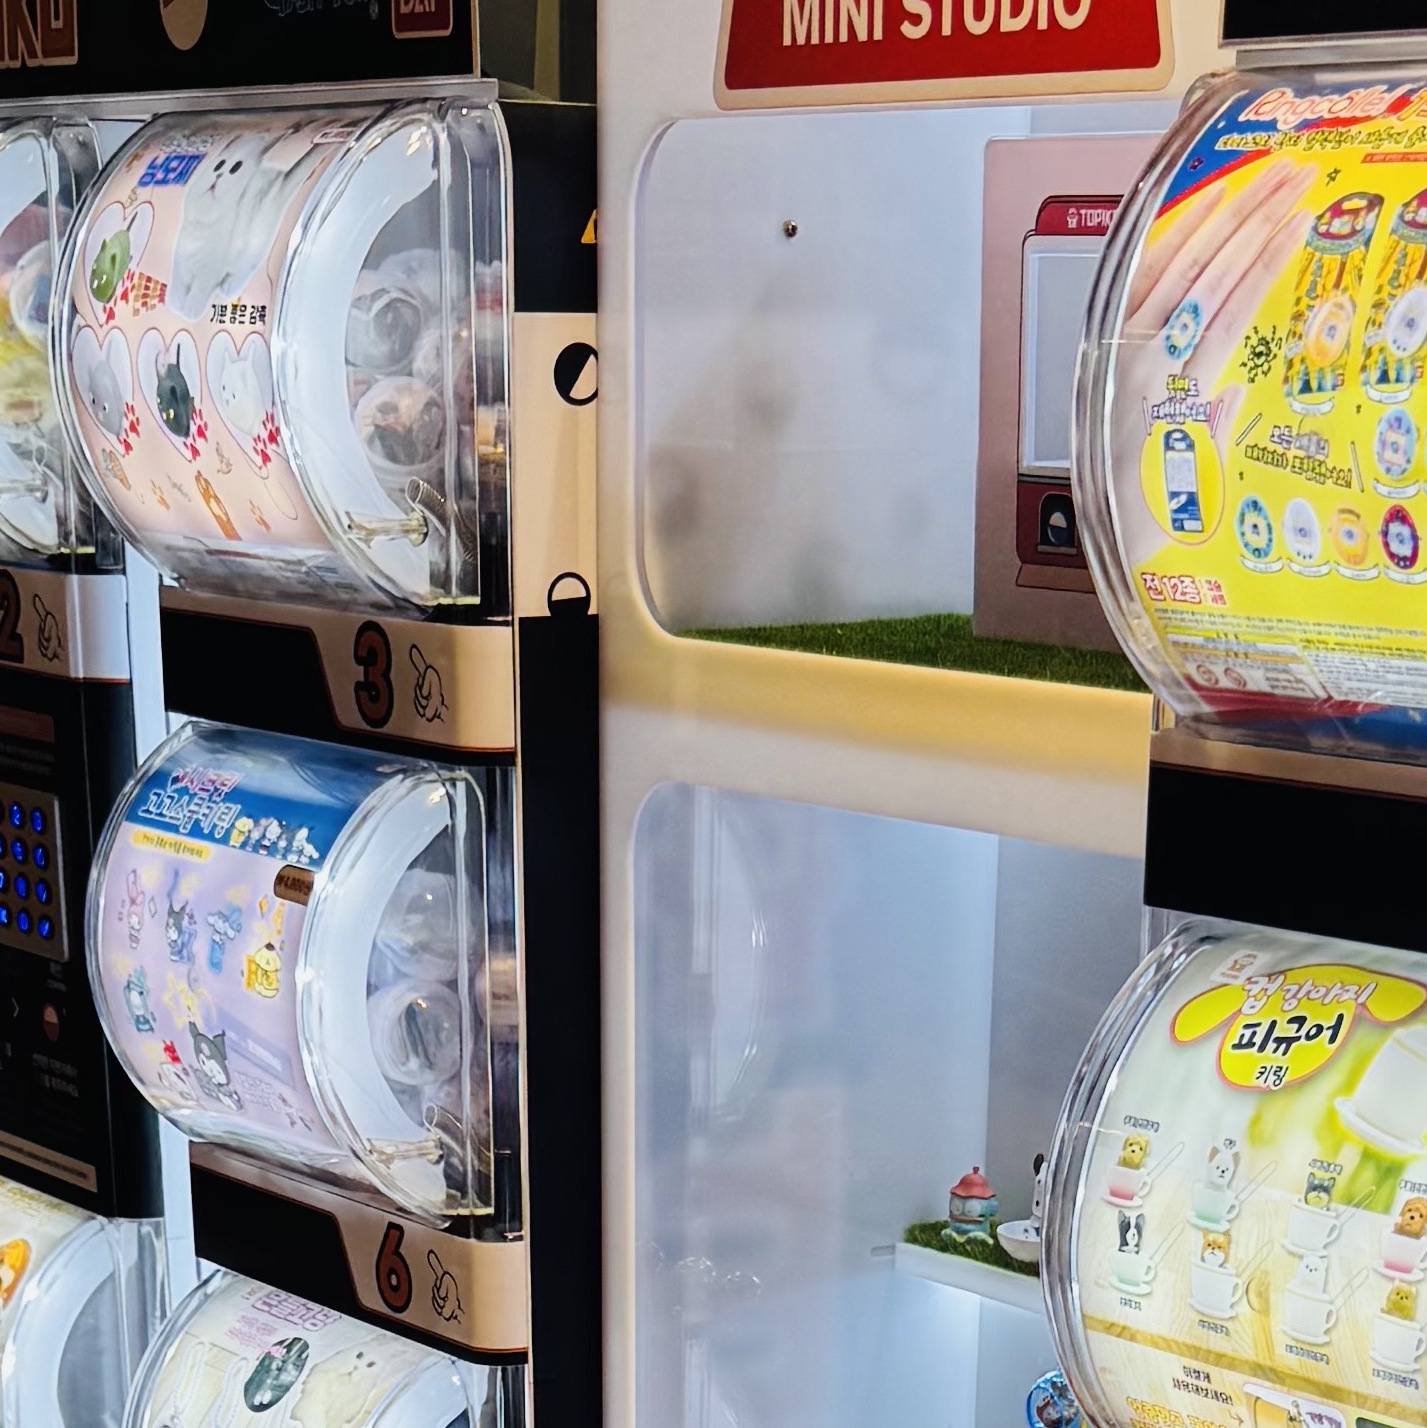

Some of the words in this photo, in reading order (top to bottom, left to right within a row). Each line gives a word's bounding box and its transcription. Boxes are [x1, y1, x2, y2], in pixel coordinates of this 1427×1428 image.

[782, 0, 883, 46] MINI
[899, 0, 1092, 40] STUDIO
[353, 620, 395, 729] 3
[1240, 973, 1287, 1015] 컵
[1281, 980, 1378, 1013] 강아지
[1231, 1012, 1346, 1057] 피규어
[1255, 1063, 1290, 1088] 키링
[375, 1221, 413, 1315] 6
